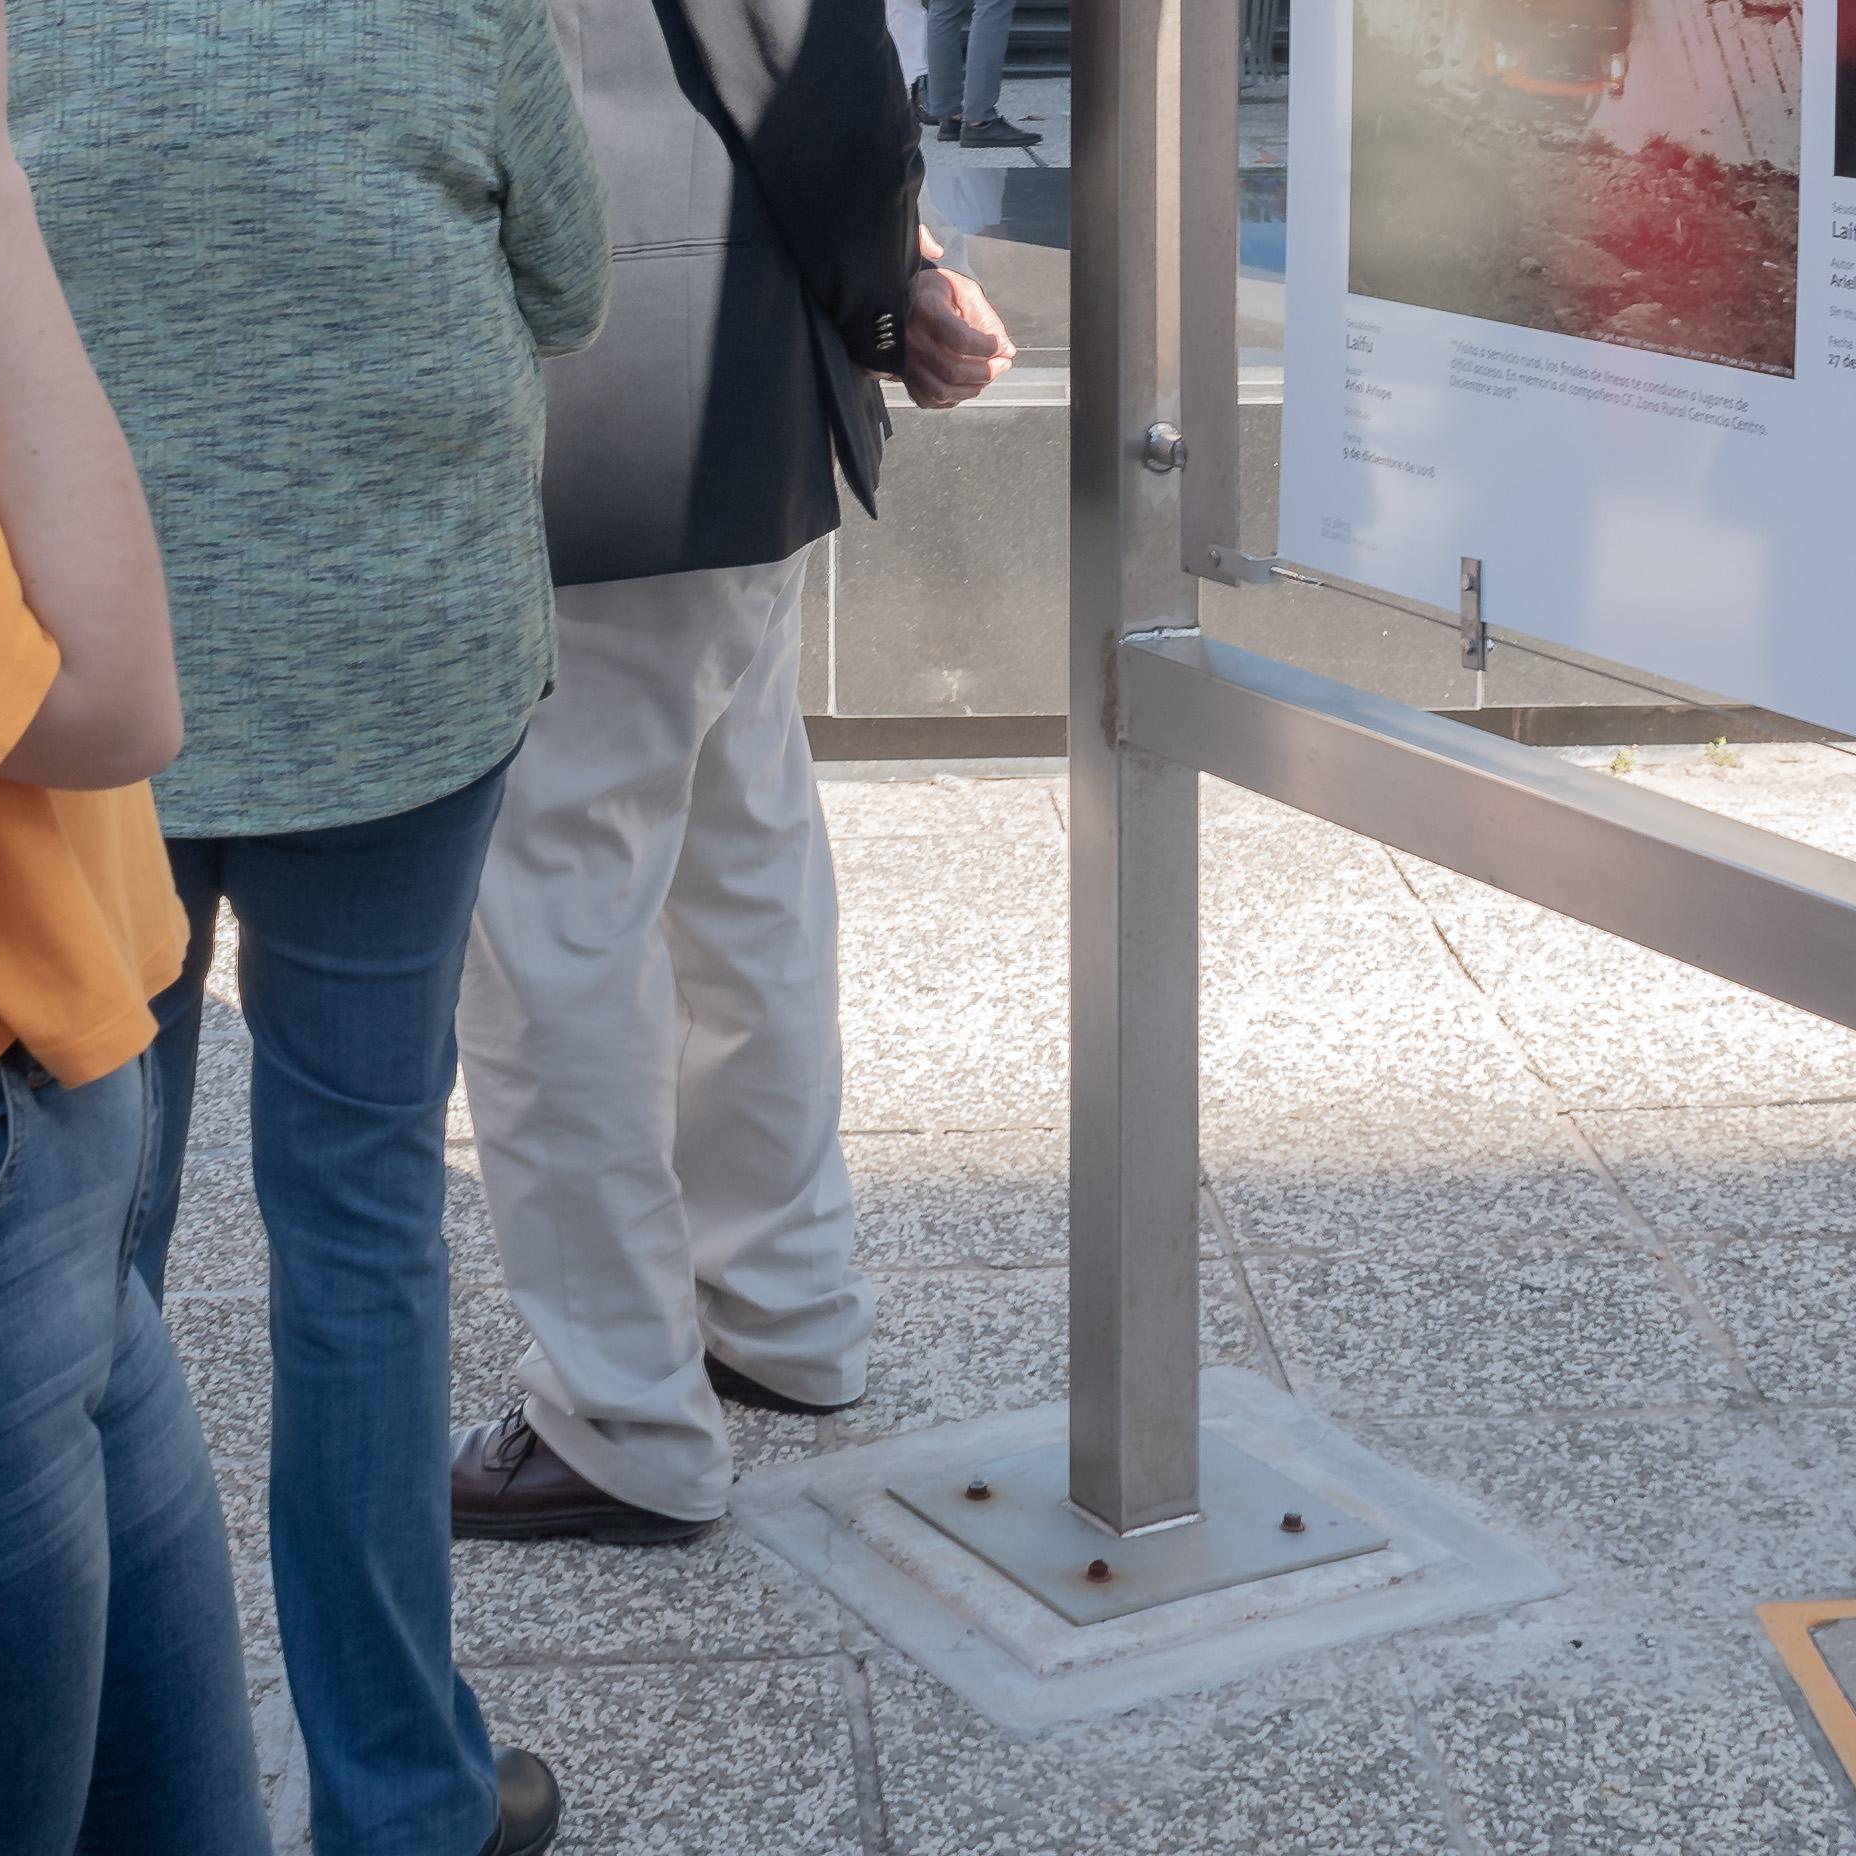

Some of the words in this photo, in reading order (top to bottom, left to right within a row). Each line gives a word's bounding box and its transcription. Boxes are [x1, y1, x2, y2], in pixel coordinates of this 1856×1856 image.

[1830, 273, 1856, 290] Ariel
[1827, 353, 1841, 368] 27
[1842, 354, 1856, 369] de
[1699, 389, 1733, 409] lugares
[1735, 397, 1749, 412] de
[1636, 396, 1660, 412] Zona
[1661, 401, 1687, 418] Rural
[1688, 407, 1730, 428] Gerencia
